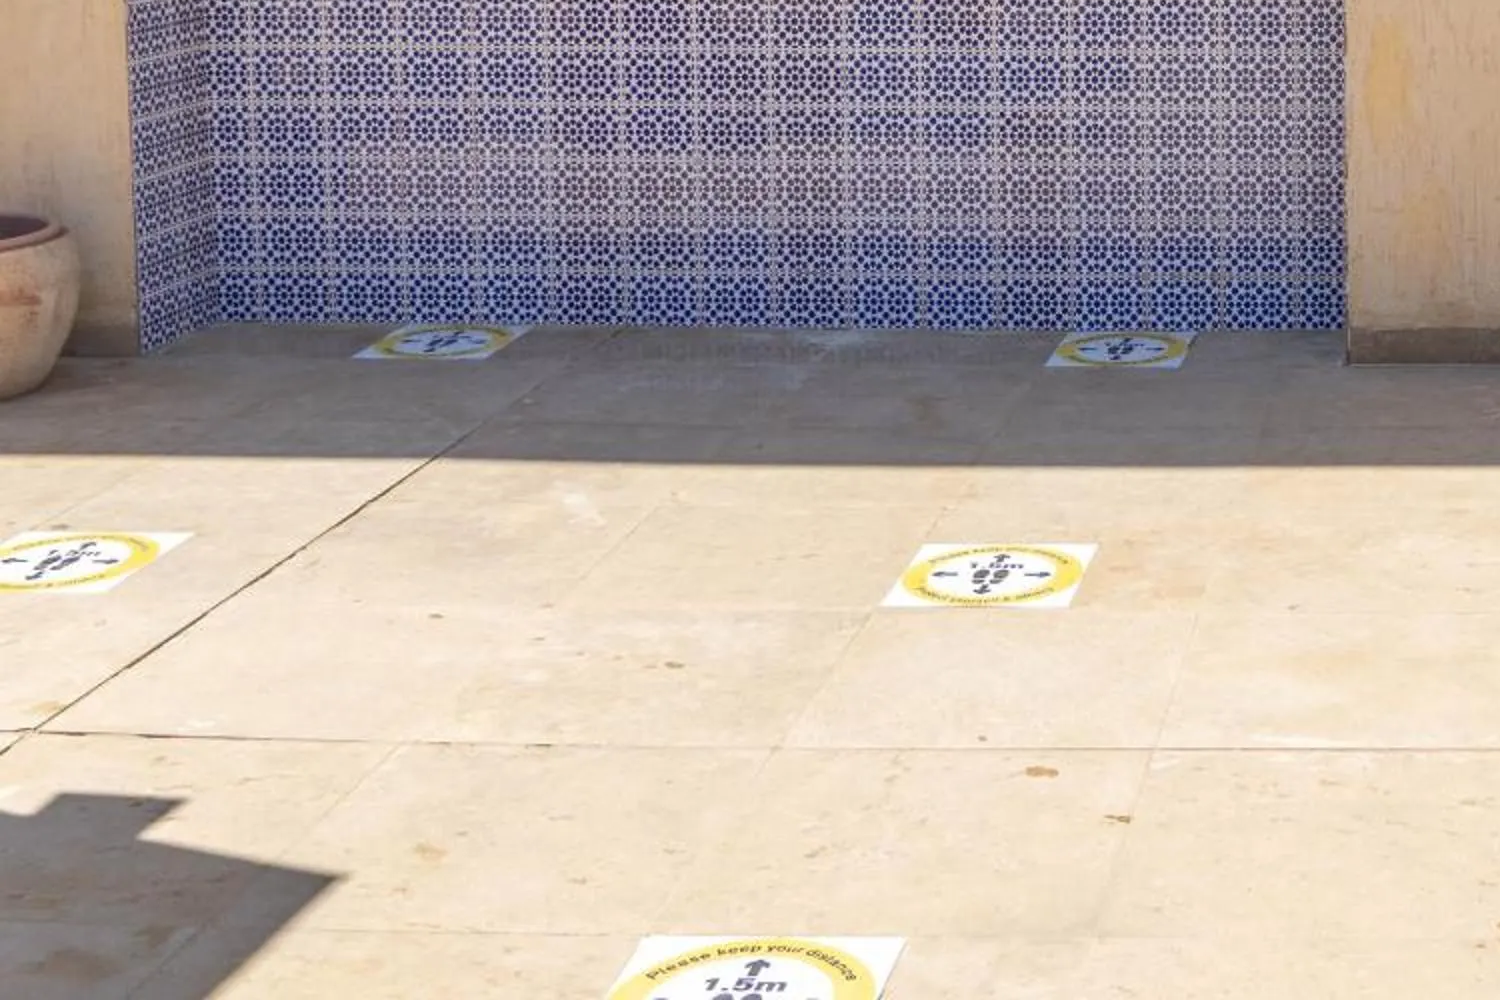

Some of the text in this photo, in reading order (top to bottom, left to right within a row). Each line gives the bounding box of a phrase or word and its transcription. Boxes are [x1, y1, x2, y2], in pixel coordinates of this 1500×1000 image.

[645, 952, 711, 981] Please
[717, 945, 761, 956] keep
[767, 944, 804, 953] your
[704, 977, 787, 992] 1.5m
